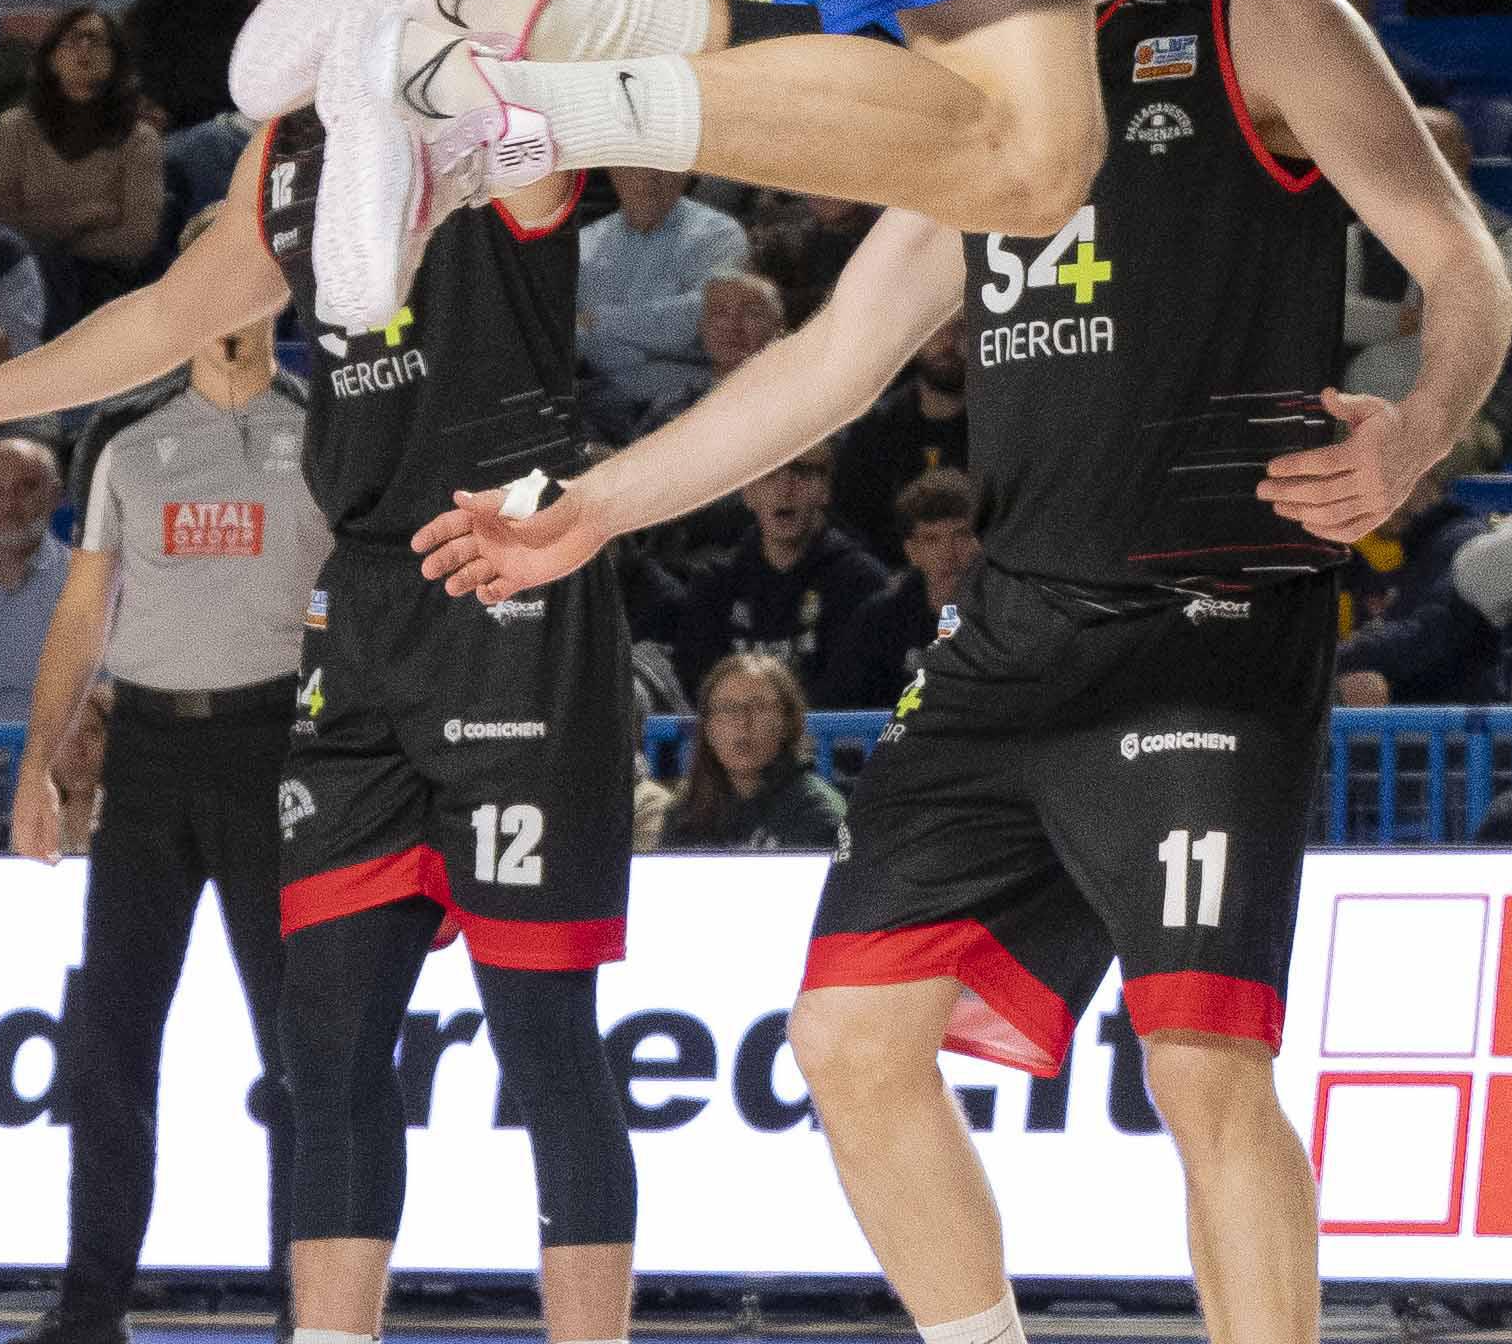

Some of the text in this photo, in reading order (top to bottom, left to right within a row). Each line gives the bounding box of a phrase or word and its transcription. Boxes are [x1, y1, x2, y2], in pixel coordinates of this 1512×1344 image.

[980, 315, 1114, 367] ENERGIA
[471, 804, 544, 886] 12
[1158, 830, 1228, 928] 11
